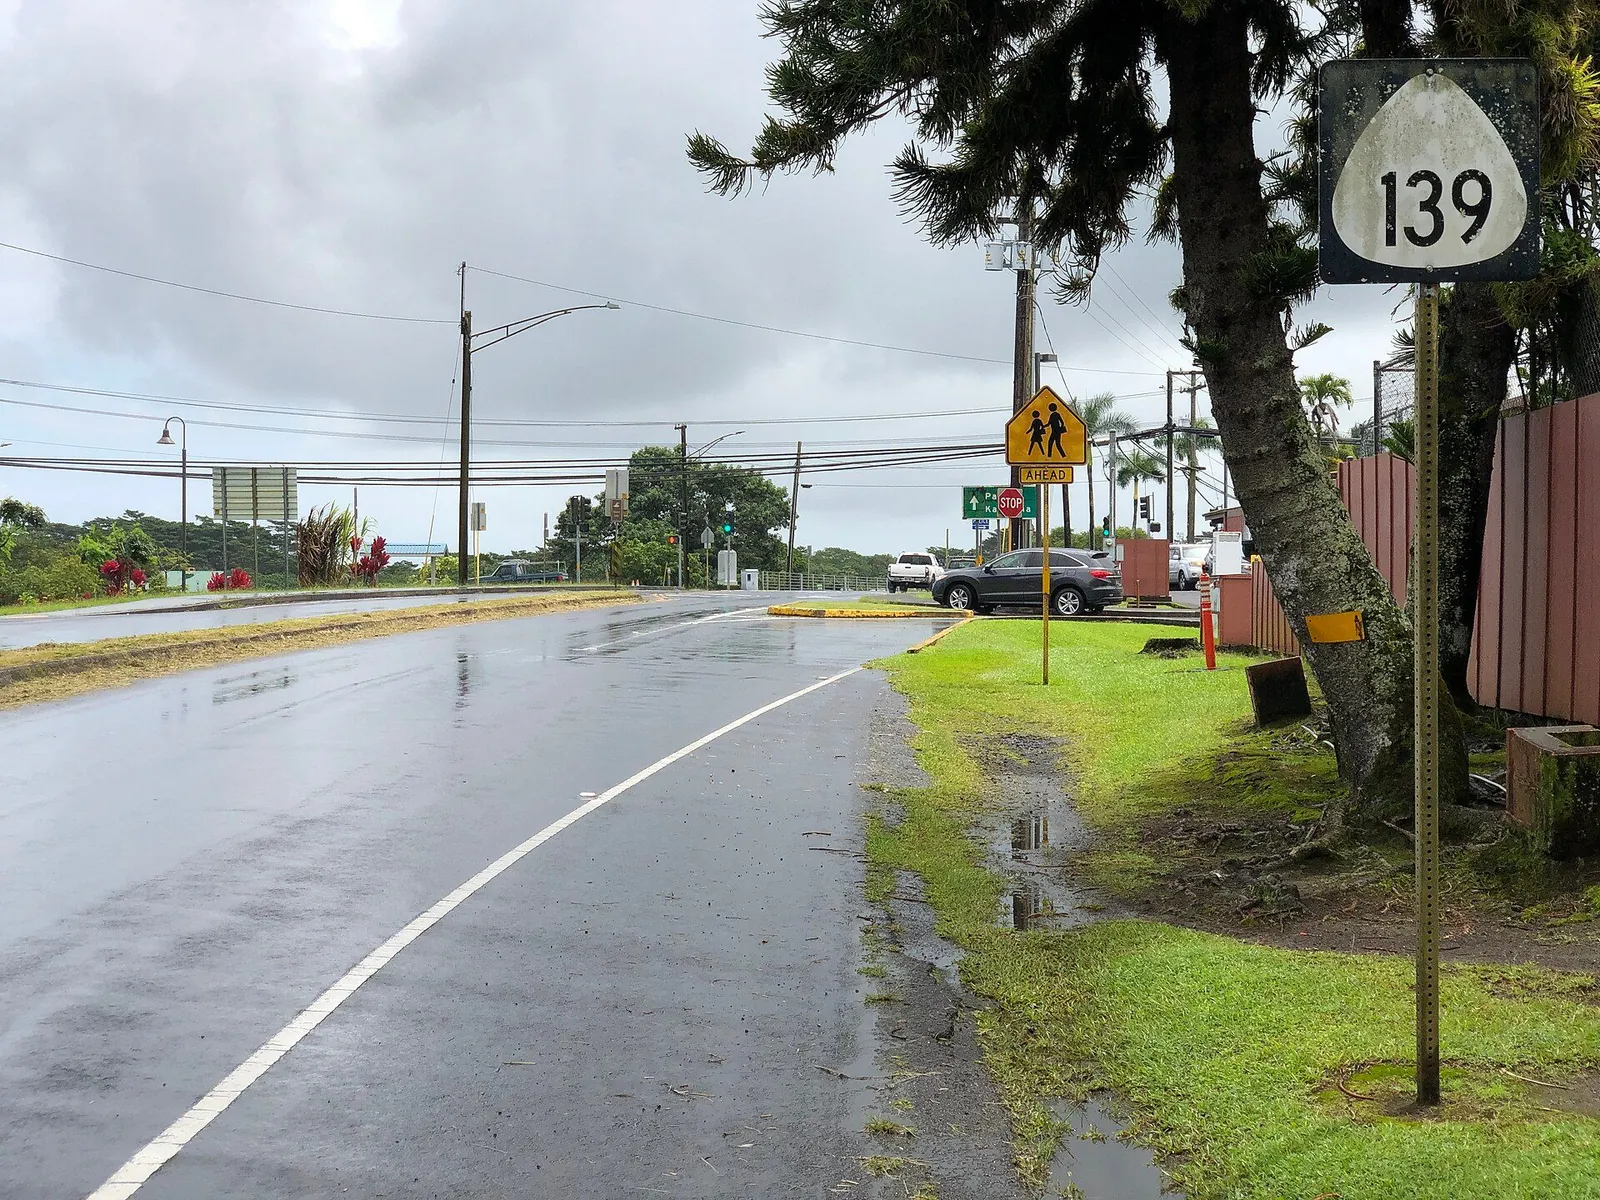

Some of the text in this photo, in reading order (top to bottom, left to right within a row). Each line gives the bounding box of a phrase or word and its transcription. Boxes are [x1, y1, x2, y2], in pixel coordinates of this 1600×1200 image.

[1381, 168, 1493, 247] 139
[1026, 469, 1066, 480] AHEAD
[1000, 497, 1022, 508] STOP
